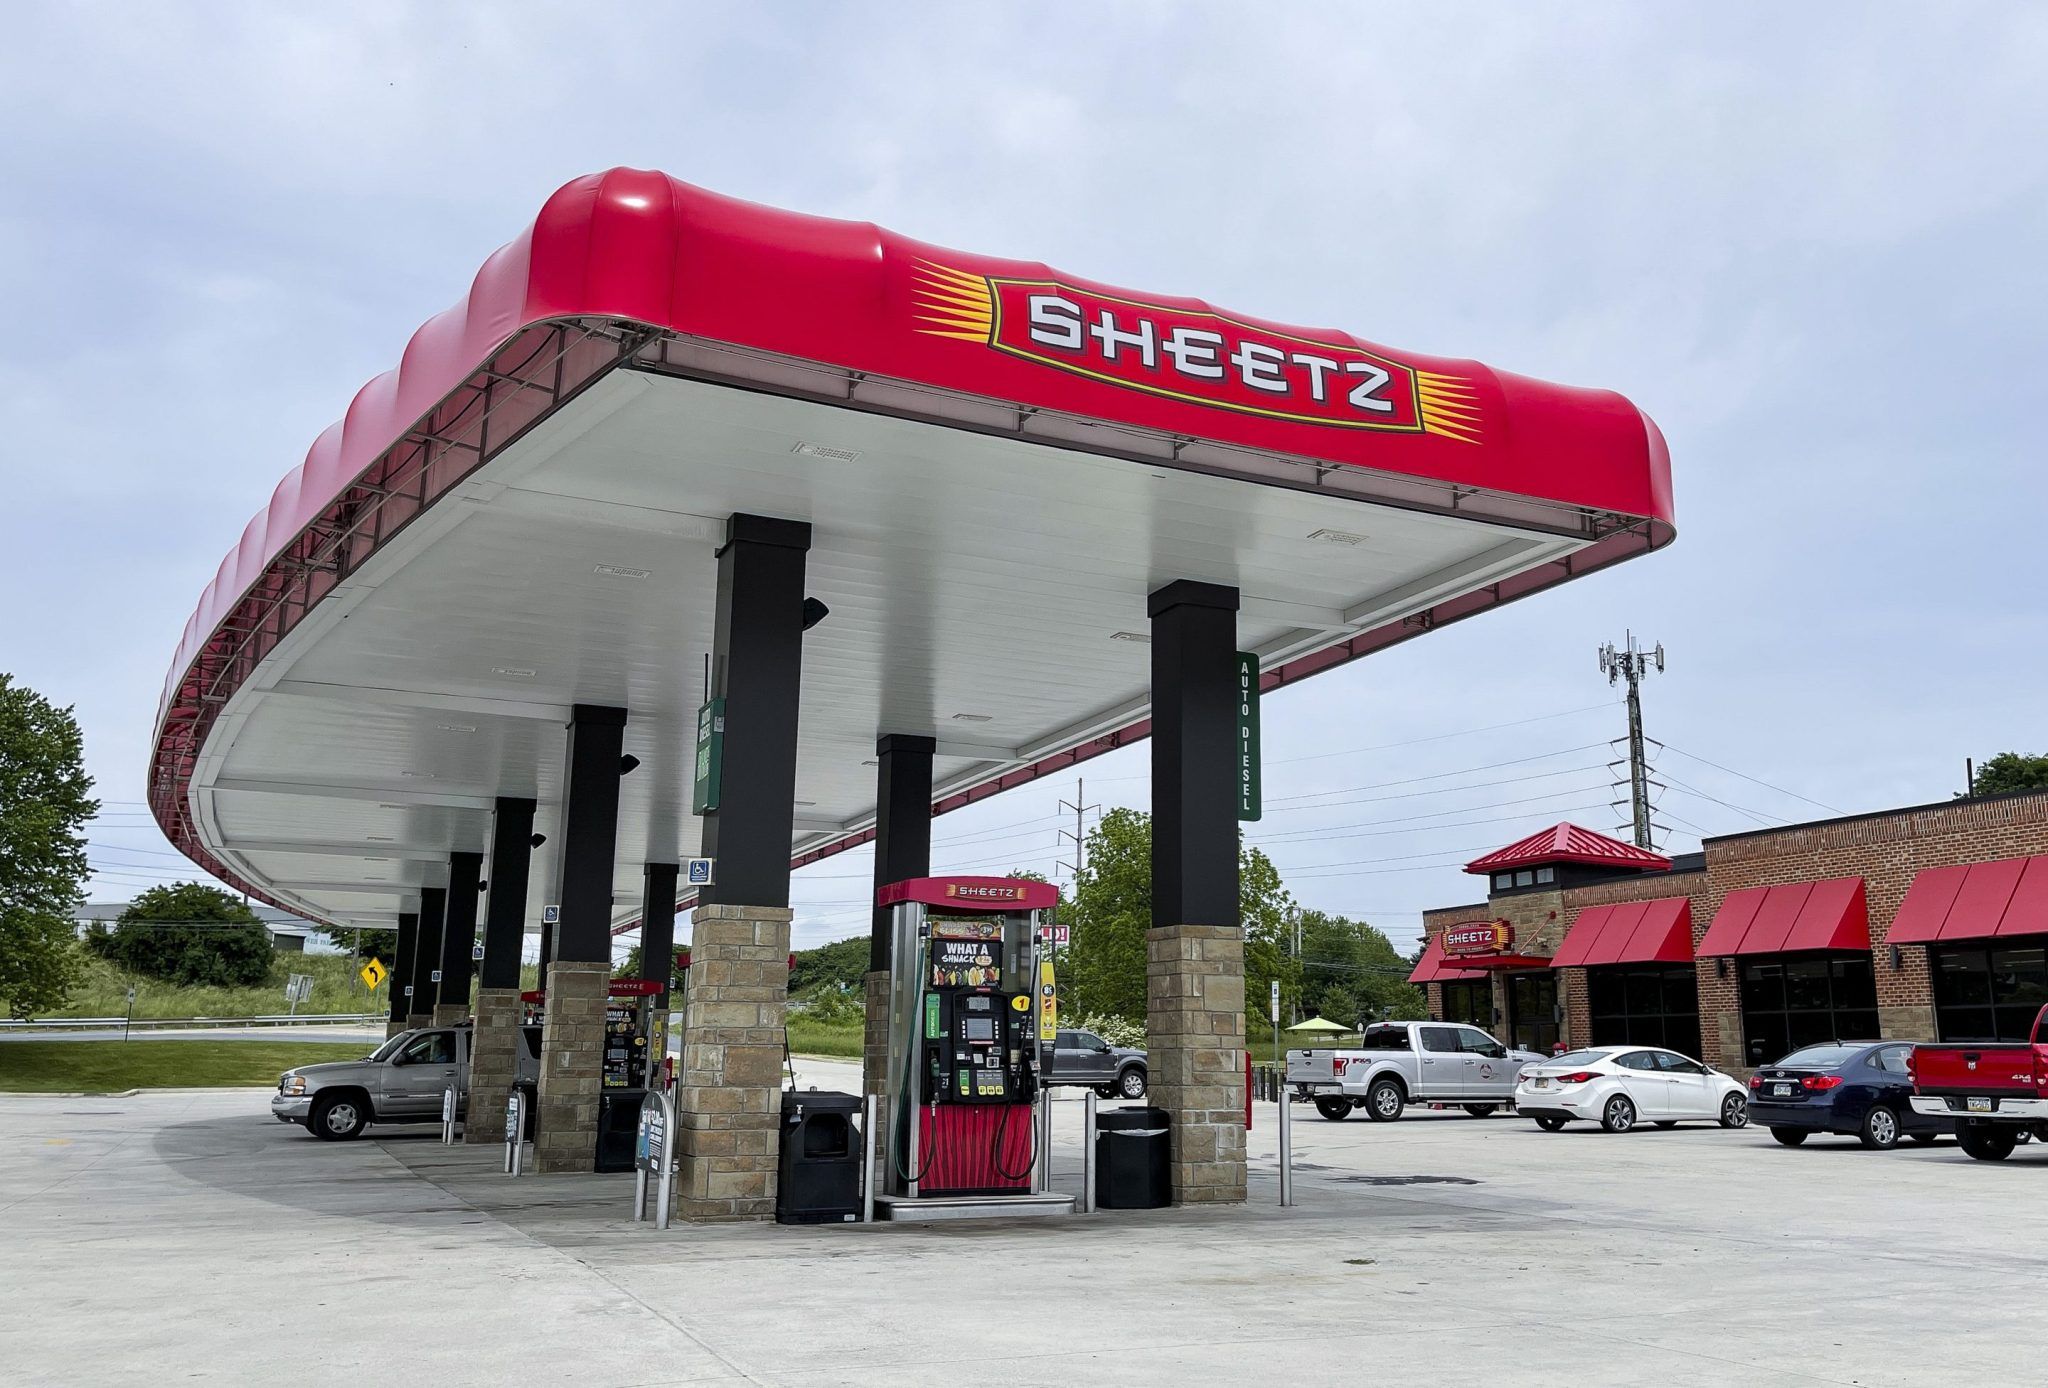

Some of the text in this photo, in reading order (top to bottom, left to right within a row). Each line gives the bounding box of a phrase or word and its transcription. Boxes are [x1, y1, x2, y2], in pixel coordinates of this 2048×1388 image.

[1028, 295, 1393, 413] SHEETZ
[1241, 662, 1250, 810] AUTO DIESEL
[959, 887, 1014, 897] SHEETZ
[1447, 930, 1493, 945] SHEETZ
[946, 943, 989, 955] WHAT A
[941, 954, 976, 963] SHNACK
[1019, 998, 1025, 1008] 1
